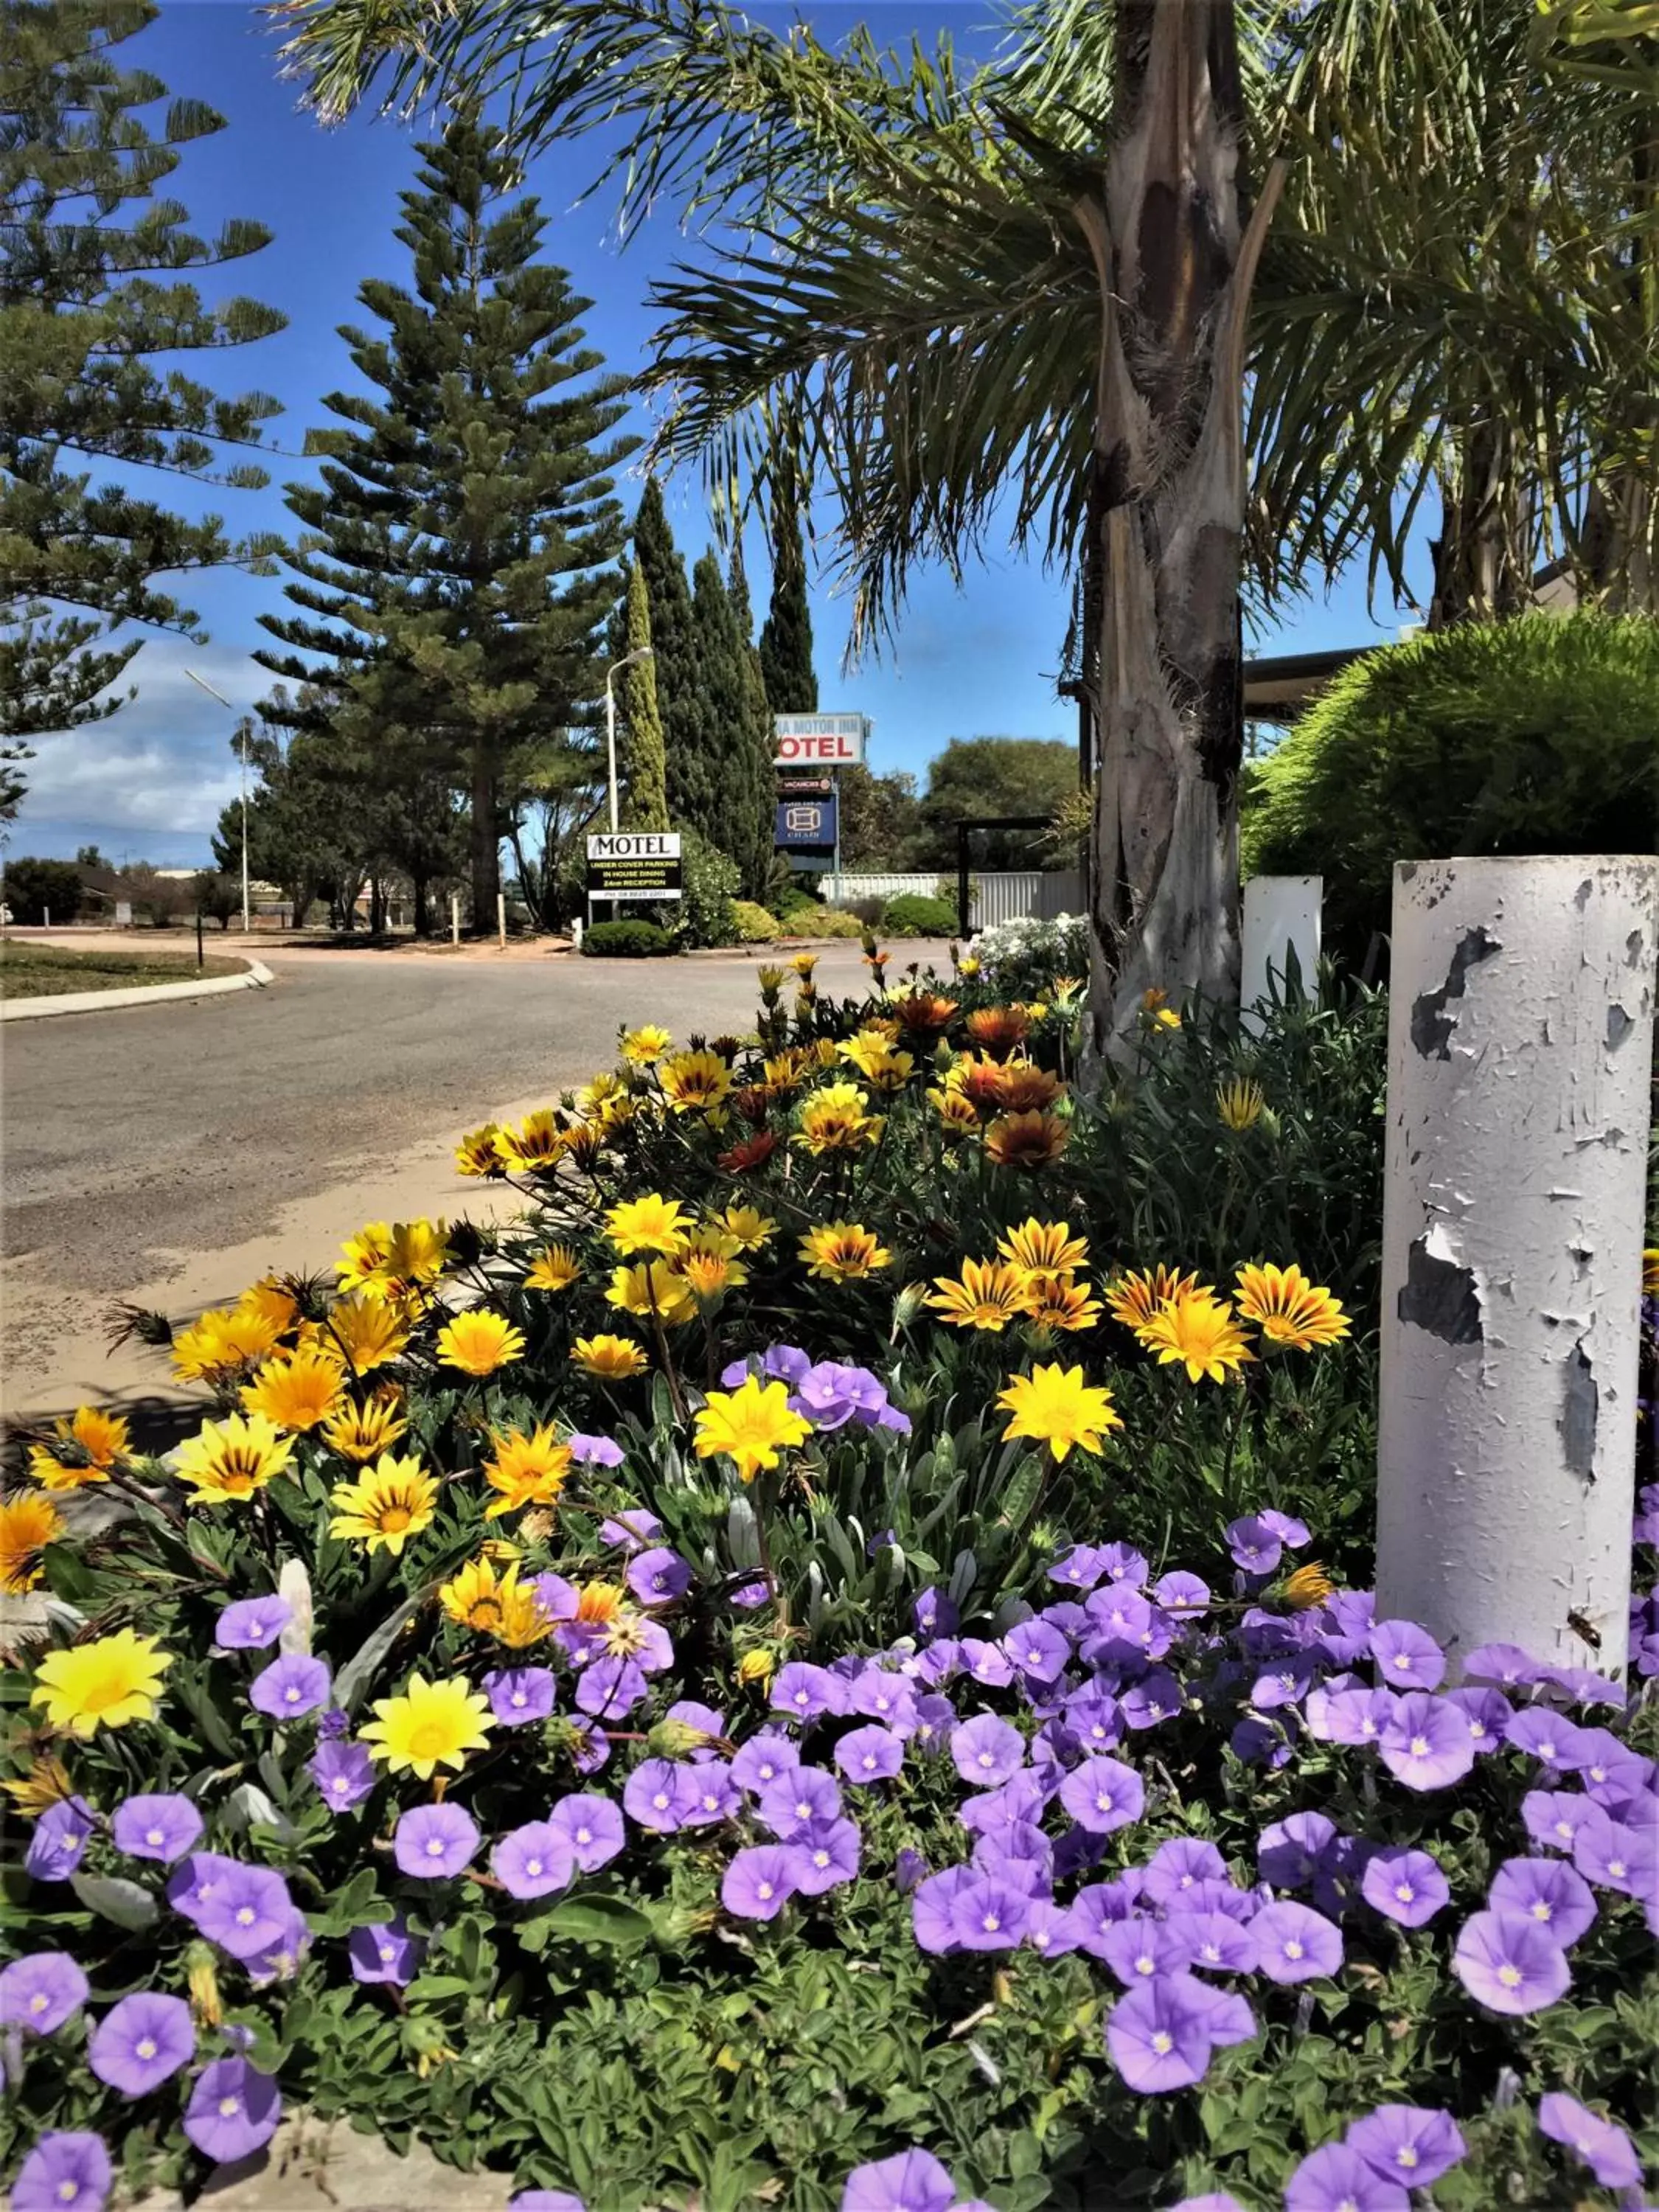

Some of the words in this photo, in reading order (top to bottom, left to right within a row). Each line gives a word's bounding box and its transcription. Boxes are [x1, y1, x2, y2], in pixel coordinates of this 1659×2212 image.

[794, 718, 835, 734] MOTOR
[839, 718, 858, 733] INN
[779, 737, 853, 759] OTEL
[598, 836, 671, 855] MOTEL
[644, 860, 679, 868] PARKING
